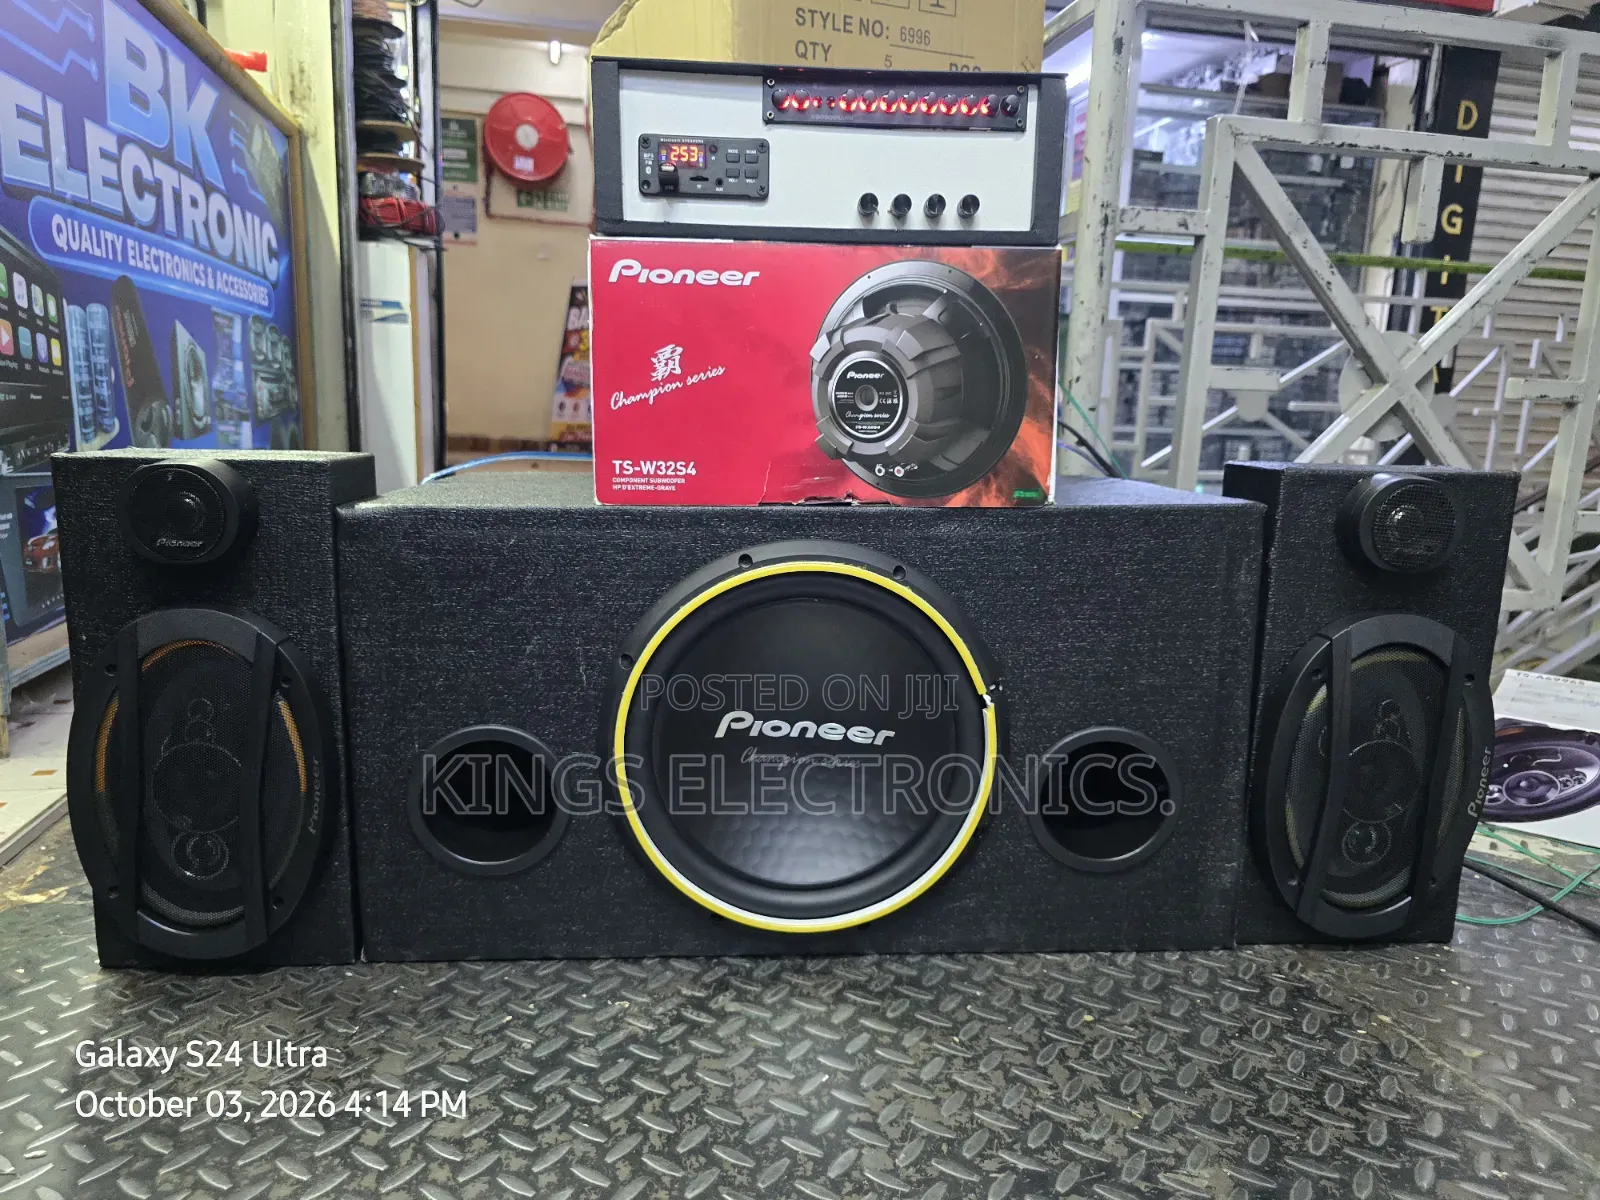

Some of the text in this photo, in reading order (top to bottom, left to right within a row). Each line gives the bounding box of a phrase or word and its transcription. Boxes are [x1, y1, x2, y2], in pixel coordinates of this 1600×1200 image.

[795, 7, 931, 46] STYLE NO: 6996
[795, 40, 832, 62] QTY
[884, 54, 893, 68] 5
[104, 0, 227, 193] BK
[670, 146, 698, 162] 253
[0, 70, 280, 284] ELECTRONIC
[51, 213, 269, 307] QUALITY ELECTRONICS & ACCESSORIES
[608, 258, 760, 286] Pioneer
[610, 366, 725, 410] Champion series
[846, 371, 885, 379] Pioneer
[612, 460, 697, 475] TS-W32S4
[714, 710, 896, 746] Pioneer
[1467, 746, 1491, 818] Pioneer
